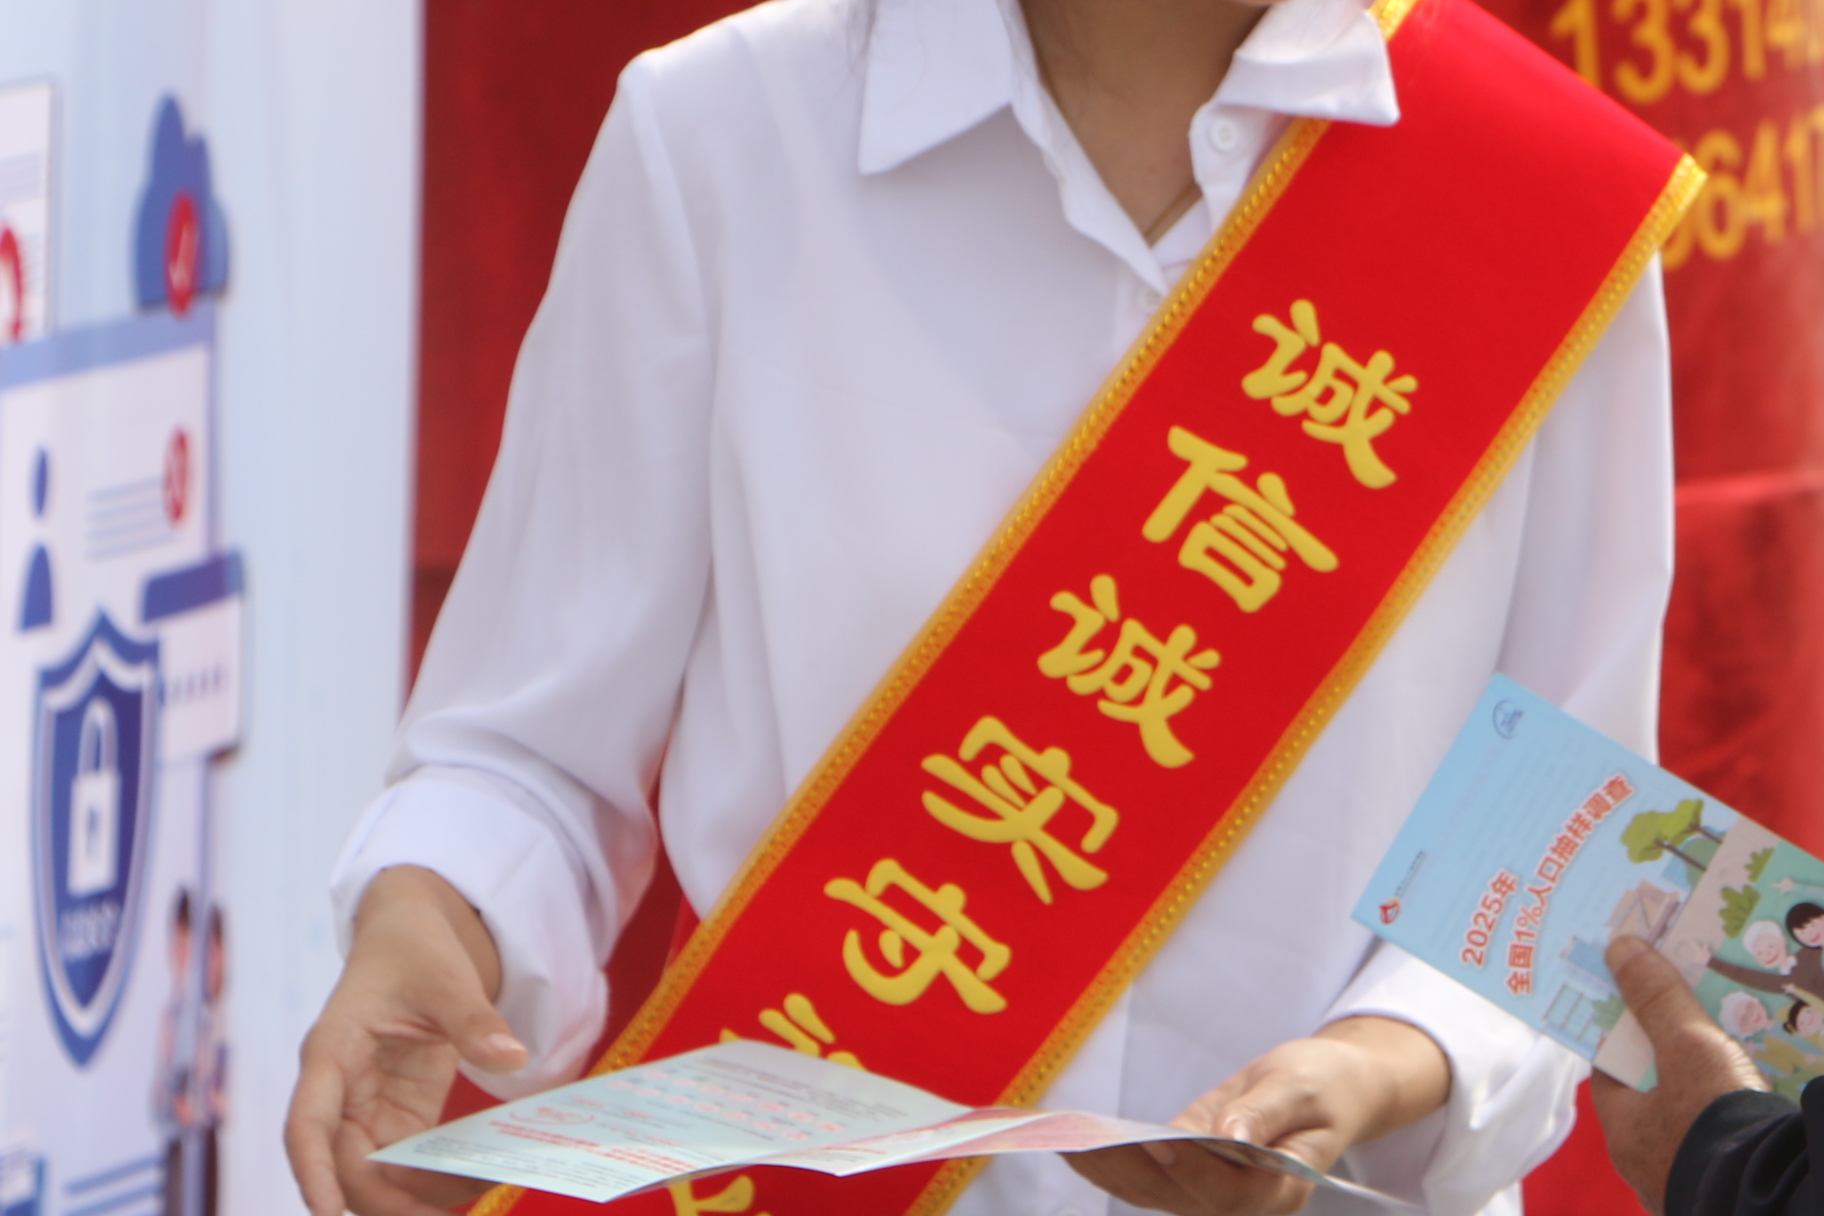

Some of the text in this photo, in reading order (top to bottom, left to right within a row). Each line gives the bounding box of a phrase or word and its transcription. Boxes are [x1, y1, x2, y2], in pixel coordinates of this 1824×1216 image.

[1460, 866, 1520, 968] 2025年
[1505, 773, 1635, 996] 全国1%人口抽样调查
